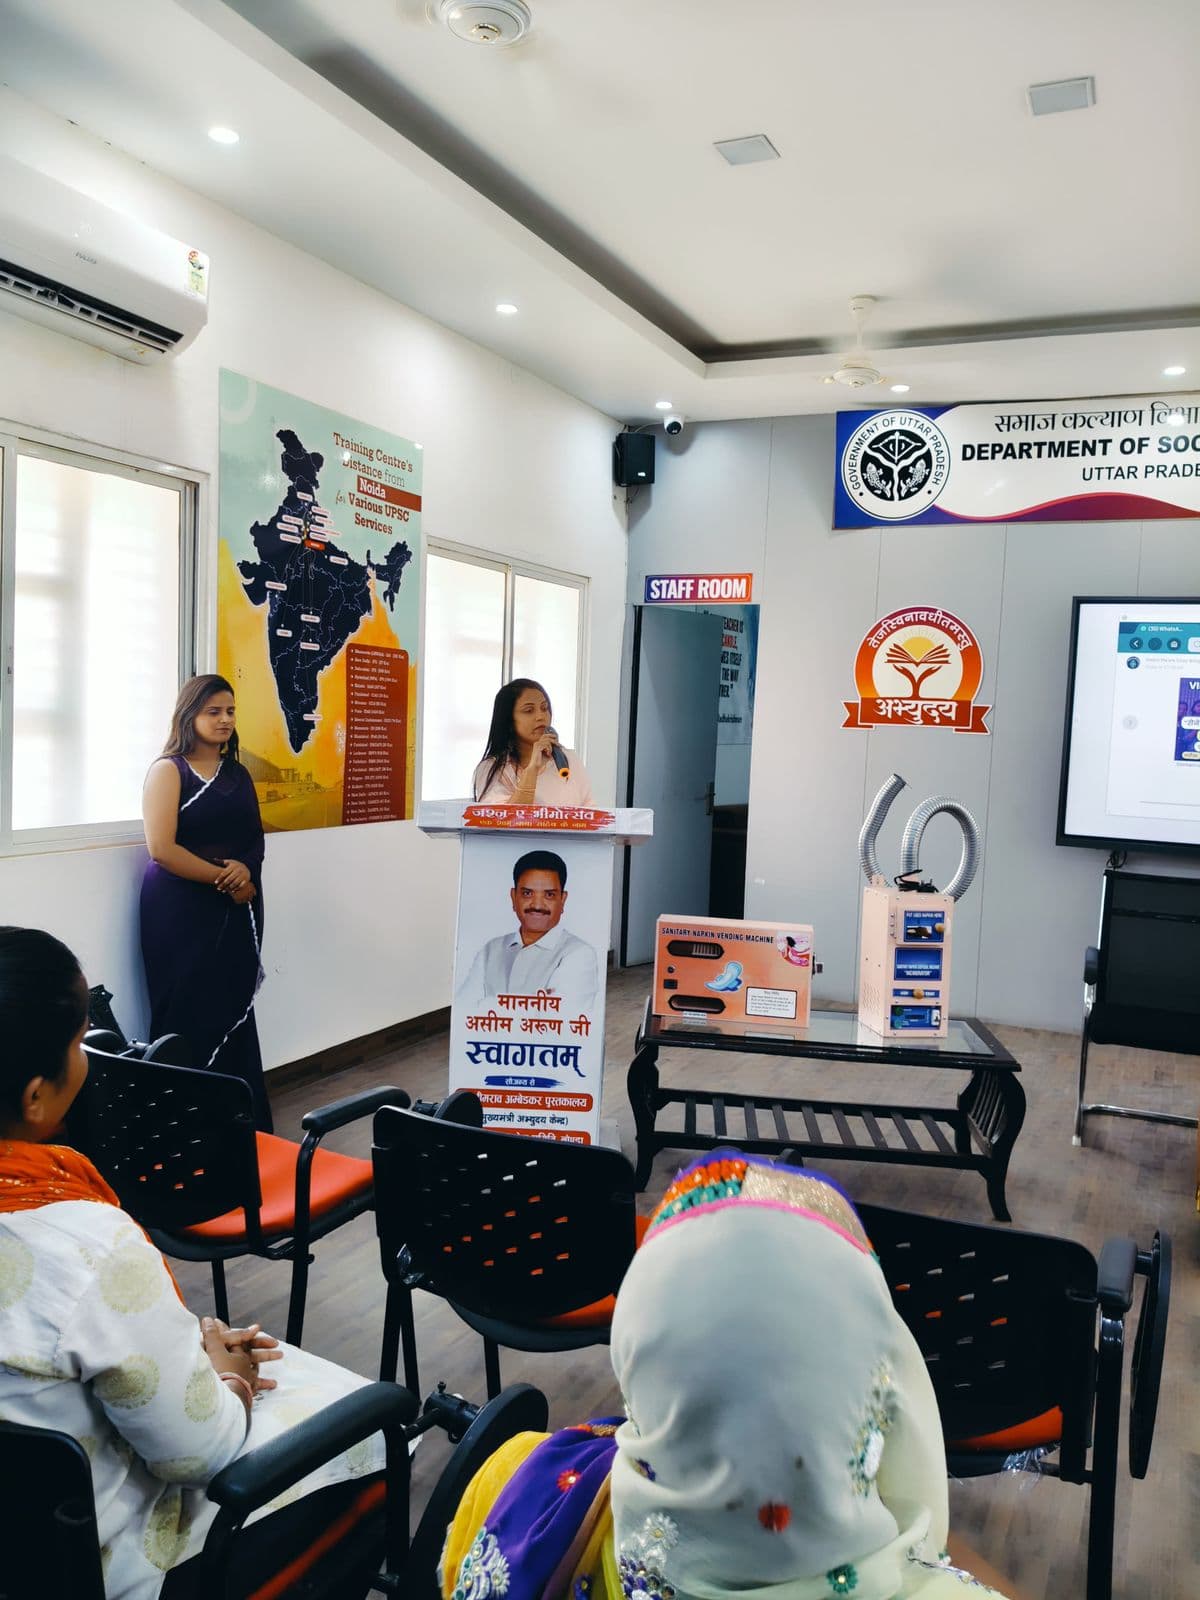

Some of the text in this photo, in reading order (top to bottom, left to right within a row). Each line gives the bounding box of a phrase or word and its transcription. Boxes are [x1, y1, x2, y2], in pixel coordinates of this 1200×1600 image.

[994, 413, 1057, 432] समाज
[1062, 409, 1145, 430] कल्याण
[333, 432, 413, 472] Training Centre's
[848, 416, 945, 490] GOVERNMENT OF UTTAR PRADESH
[962, 438, 1112, 461] DEPARTMENT
[1119, 437, 1150, 455] OF
[385, 469, 405, 487] from
[1082, 465, 1138, 481] UTTAR
[359, 478, 386, 499] Noida
[348, 493, 383, 514] Various
[385, 504, 410, 522] UPSC
[354, 512, 393, 535] Services
[650, 578, 747, 599] STAFF ROOM
[873, 698, 958, 725] अभ्युदय
[662, 927, 690, 936] SANITARY
[717, 932, 744, 941] VENDING
[746, 935, 774, 944] MACHINE
[498, 990, 561, 1012] माननीय
[466, 1010, 591, 1036] असीम अरूण जी
[466, 1041, 586, 1078] स्वागतम्
[505, 1093, 542, 1106] अम्बेडकर
[545, 1097, 587, 1108] पुस्तकालय
[517, 1115, 546, 1126] अभ्युदय
